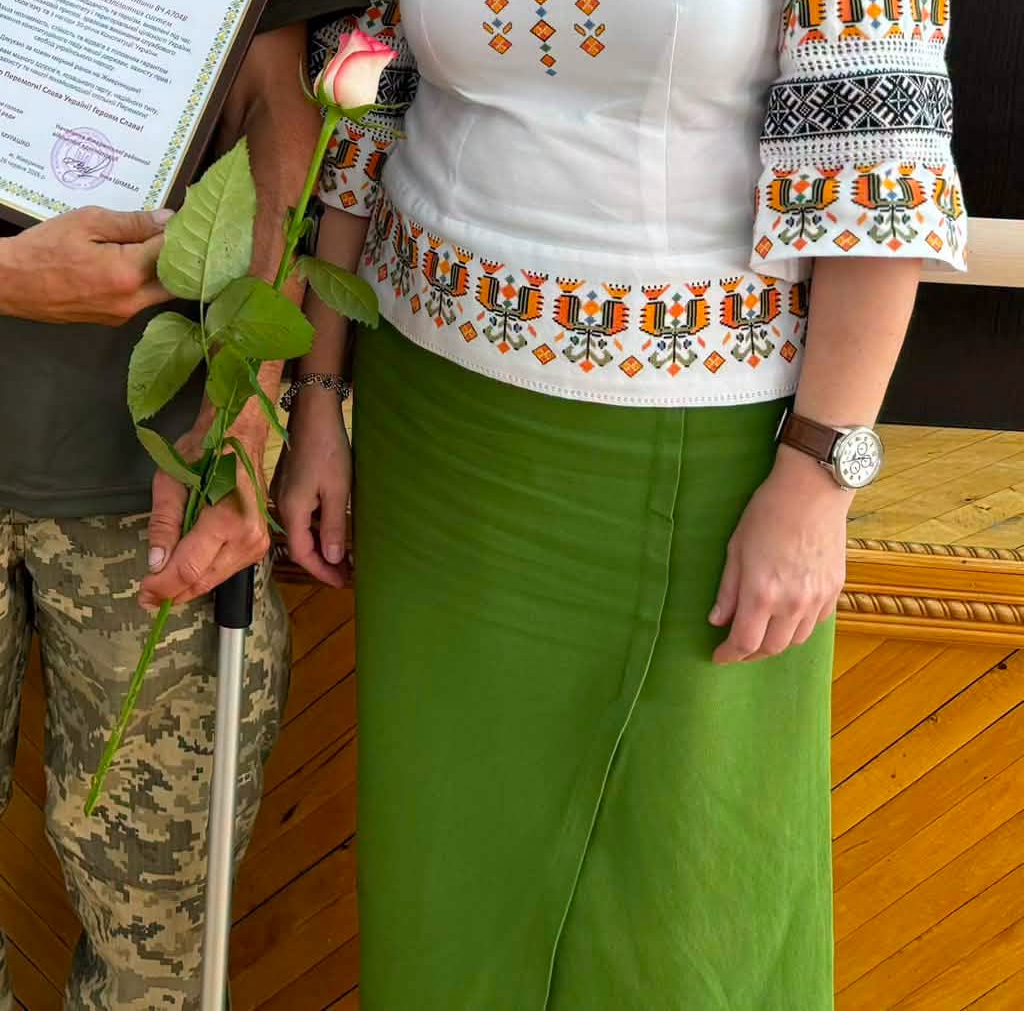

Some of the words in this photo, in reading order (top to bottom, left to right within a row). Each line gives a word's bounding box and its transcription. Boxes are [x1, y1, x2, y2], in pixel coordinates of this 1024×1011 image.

[144, 11, 173, 28] систем
[3, 70, 41, 91] Перемоги!
[41, 85, 63, 100] Слава
[63, 94, 92, 111] Україні!
[91, 105, 119, 122] Героям
[118, 116, 144, 132] Слава!
